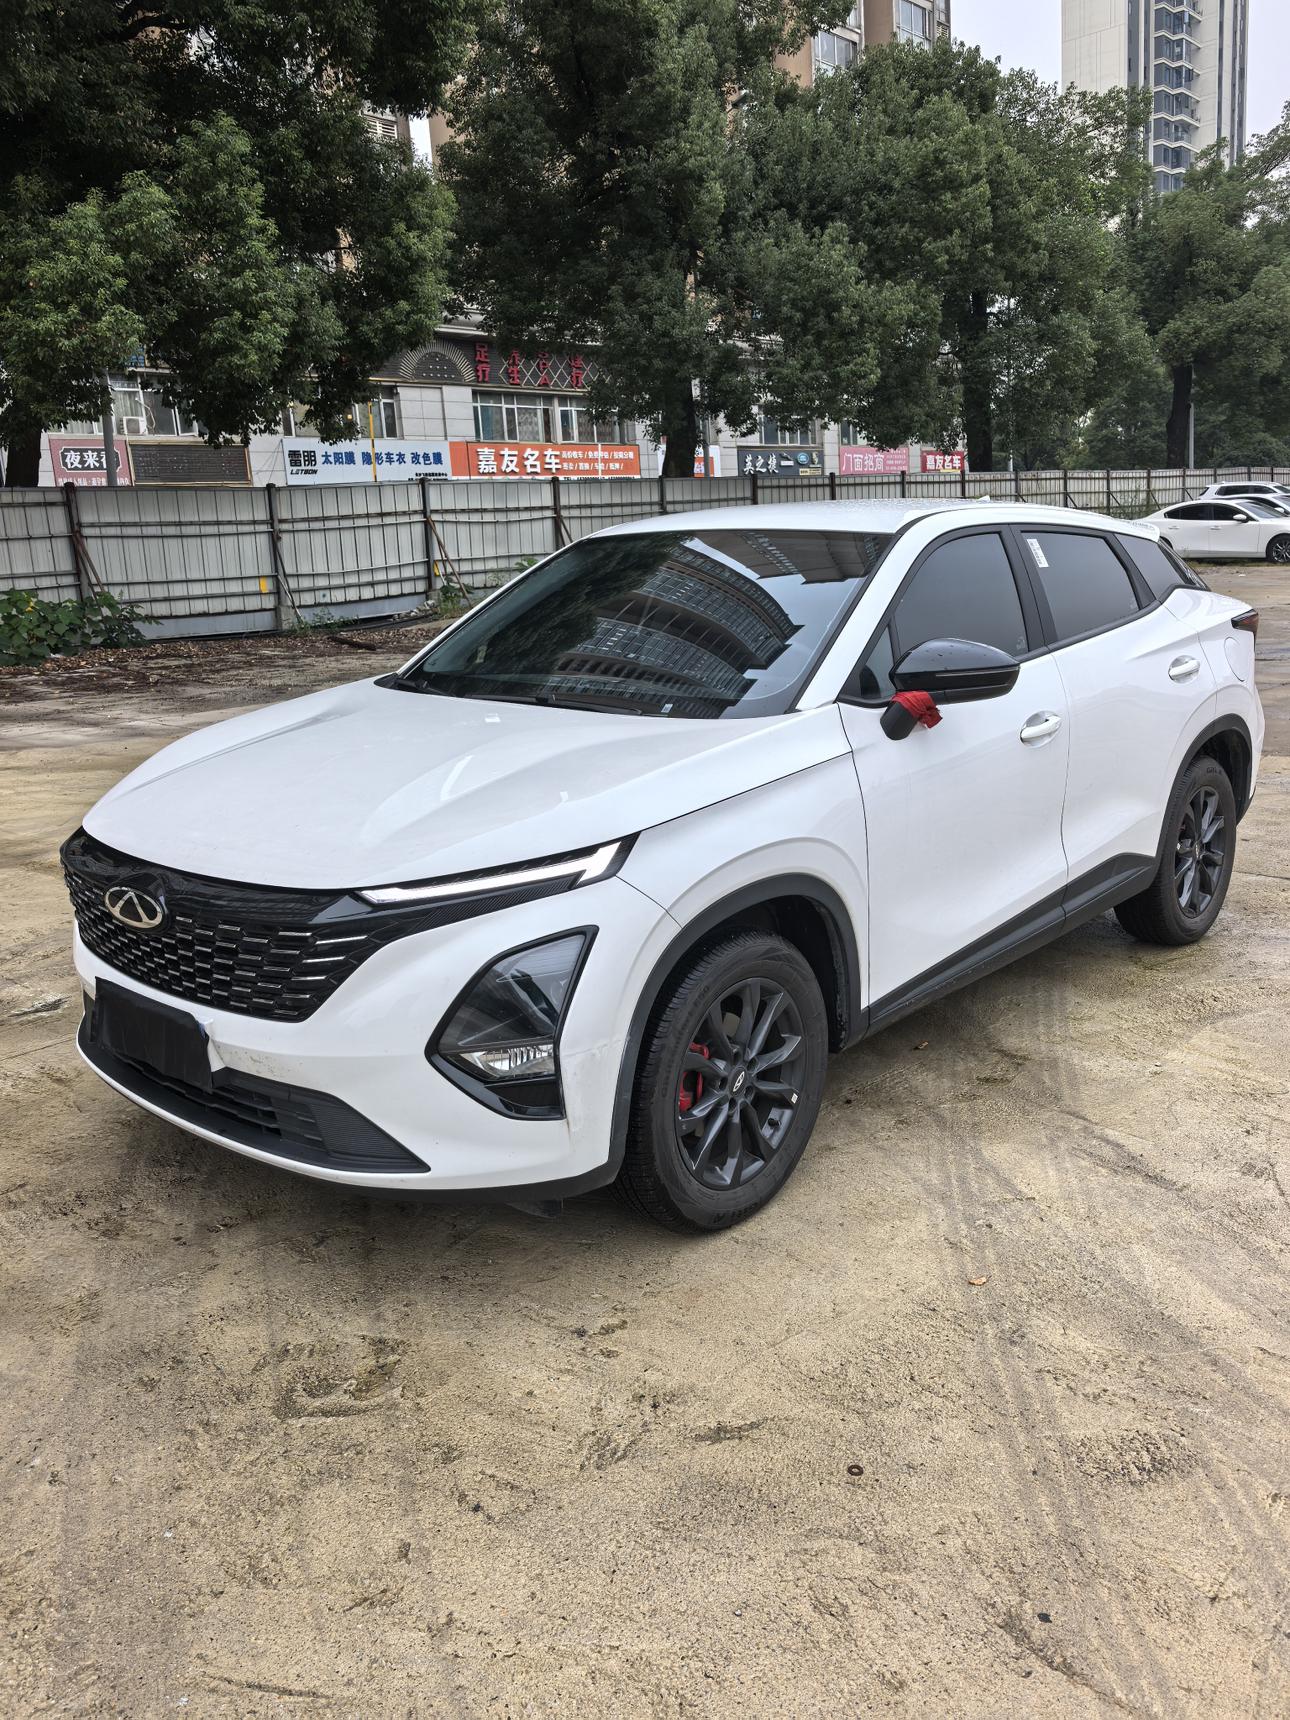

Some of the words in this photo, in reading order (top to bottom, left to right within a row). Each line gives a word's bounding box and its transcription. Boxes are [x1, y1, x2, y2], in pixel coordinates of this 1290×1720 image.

[288, 450, 317, 467] 雷朋
[321, 451, 356, 466] 太阳膜
[410, 451, 444, 466] 改色膜
[476, 448, 562, 474] 嘉友名车
[842, 452, 885, 473] 门面招商
[926, 454, 962, 470] 嘉友名车
